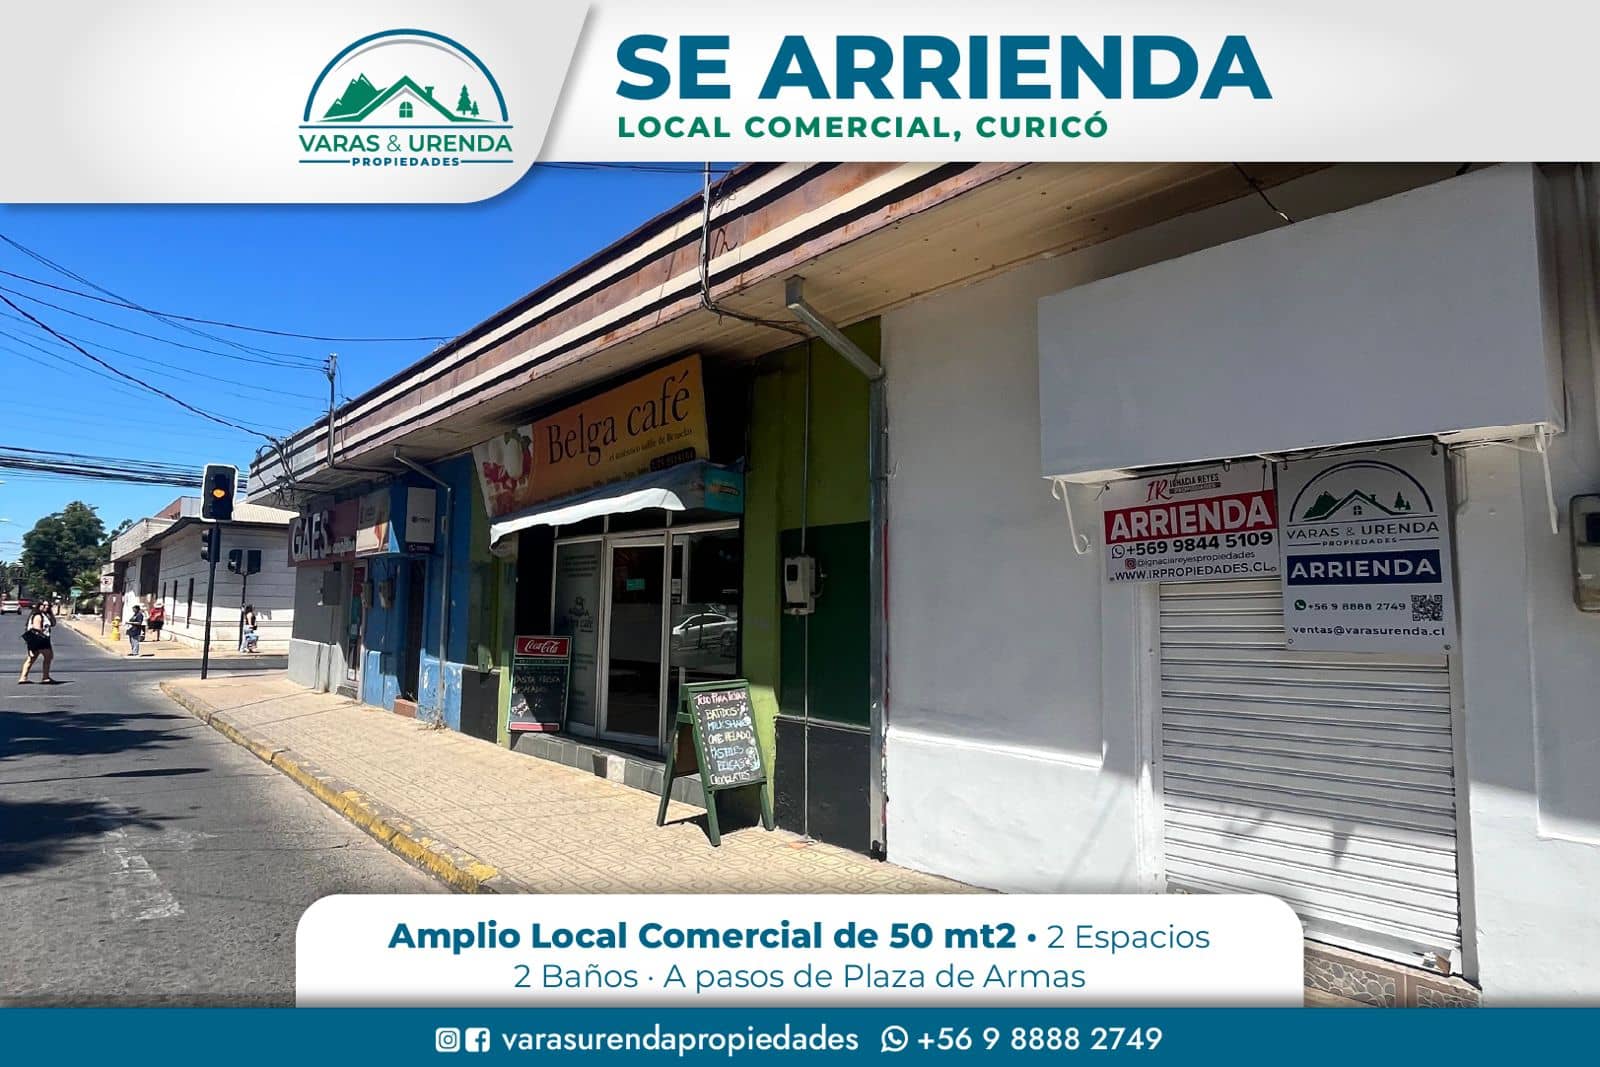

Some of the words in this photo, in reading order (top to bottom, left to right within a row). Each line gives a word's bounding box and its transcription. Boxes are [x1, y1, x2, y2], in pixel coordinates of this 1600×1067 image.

[546, 413, 617, 466] Belga
[627, 370, 690, 437] café
[1197, 473, 1219, 484] REYES
[1110, 496, 1273, 541] ARRIENDA
[1287, 527, 1340, 540] VARAS
[1361, 521, 1440, 536] URENDA
[1126, 541, 1168, 557] +569
[1172, 535, 1220, 553] 9844
[1225, 531, 1273, 548] 5109
[1322, 537, 1397, 546] PROPIEDADES
[1137, 550, 1255, 567] @ignaciareyespropiedades
[1115, 562, 1272, 581] WWW.IRPROPIEDADES.CL
[1290, 558, 1436, 579] ARRIENDA
[1308, 602, 1328, 611] +56
[1331, 602, 1338, 611] 9
[1342, 602, 1372, 611] 8888
[1376, 602, 1406, 611] 2749
[1292, 625, 1445, 637] ventas@varasurenda.cl
